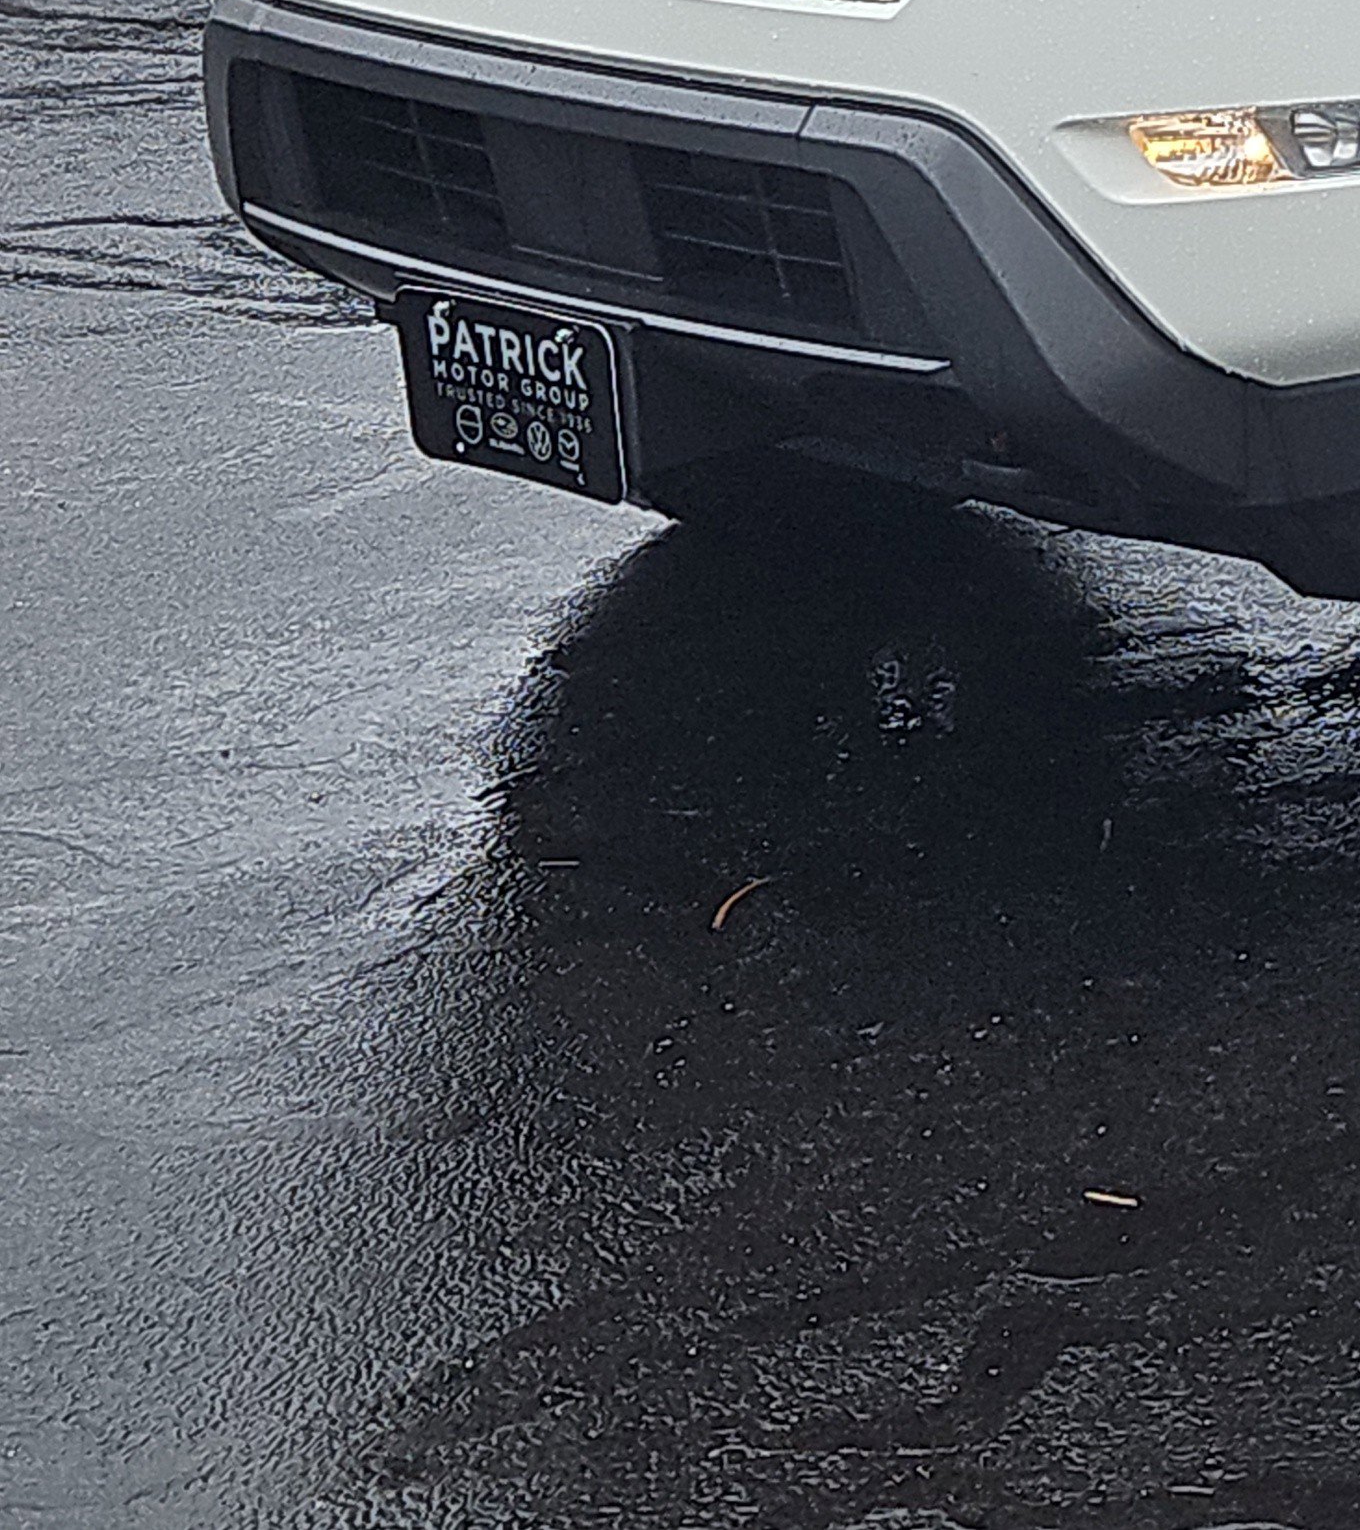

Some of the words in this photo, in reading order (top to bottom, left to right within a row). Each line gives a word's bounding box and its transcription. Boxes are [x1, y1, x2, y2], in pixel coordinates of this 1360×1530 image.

[427, 314, 587, 391] PATRICK
[433, 359, 509, 392] MOTOR
[520, 379, 589, 411] GROUP
[437, 382, 506, 410] TRUSTED
